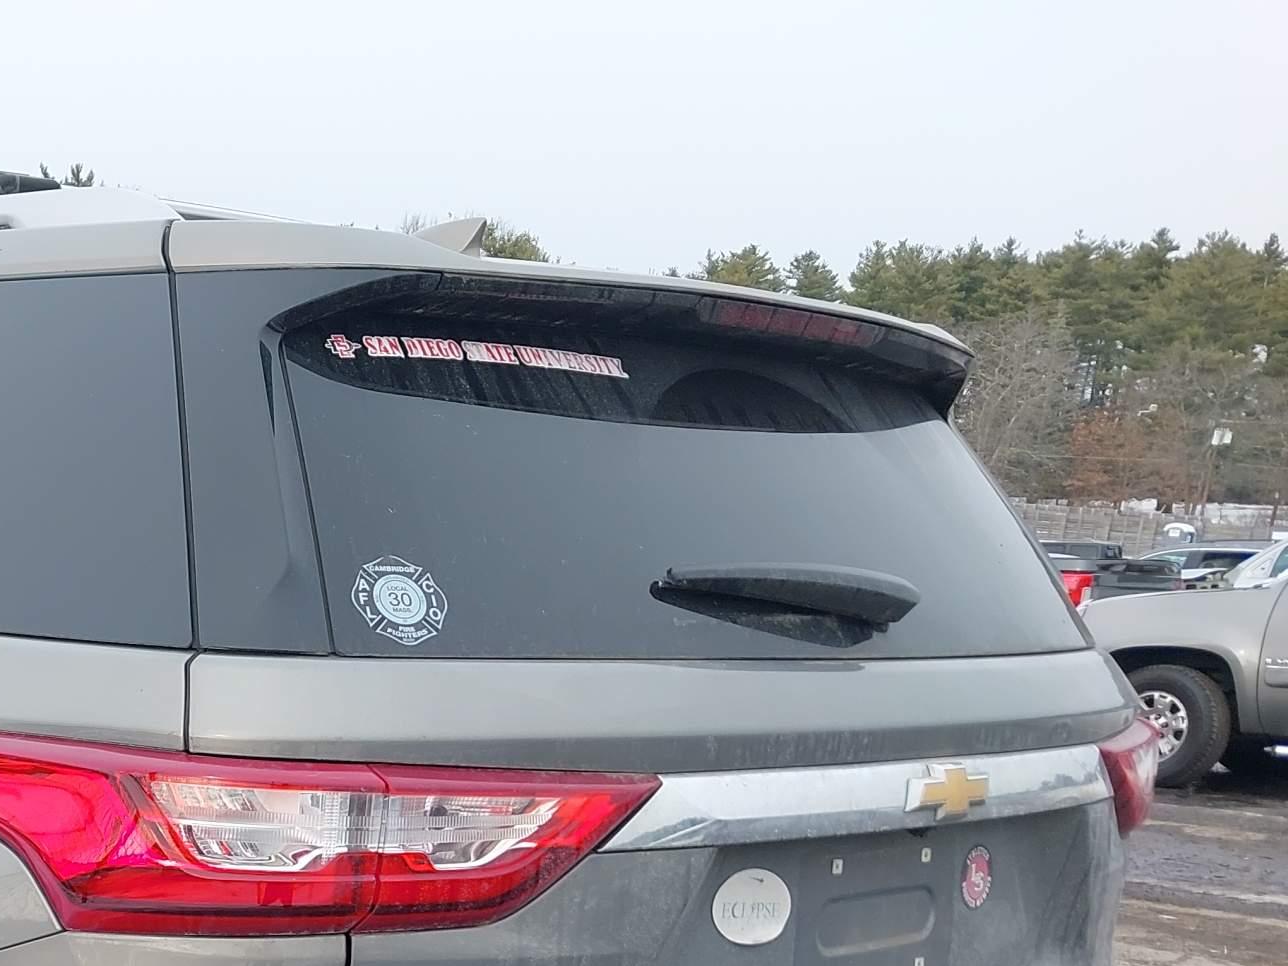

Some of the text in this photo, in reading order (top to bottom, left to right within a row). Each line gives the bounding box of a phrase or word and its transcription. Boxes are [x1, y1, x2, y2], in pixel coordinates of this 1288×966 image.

[363, 336, 629, 378] SAN DIEGO STATE UNIVERSITY
[388, 592, 412, 607] 30
